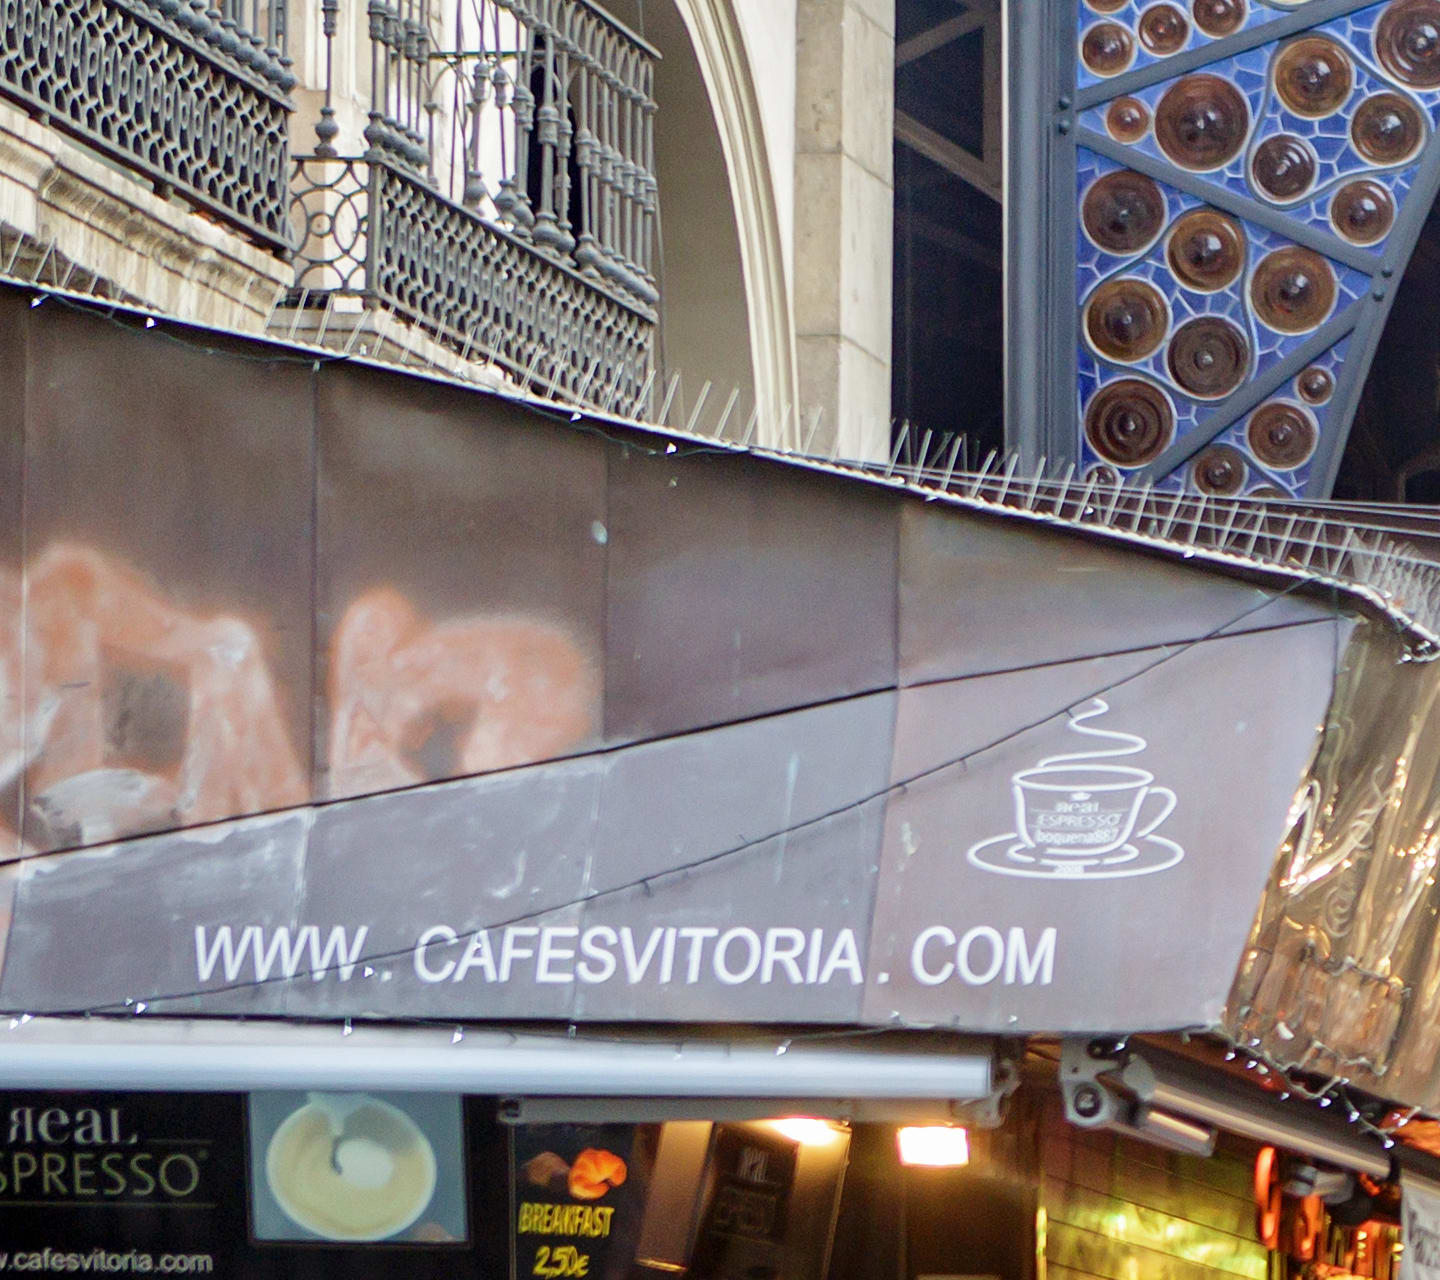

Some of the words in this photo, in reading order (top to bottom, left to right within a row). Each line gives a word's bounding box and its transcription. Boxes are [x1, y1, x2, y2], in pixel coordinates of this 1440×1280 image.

[1037, 813, 1122, 825] ESPRESSO
[911, 924, 1057, 985] COM
[0, 1151, 199, 1197] PRESSO
[518, 1202, 615, 1237] BREAKFAST
[0, 1248, 213, 1273] .cafesvitoria.com
